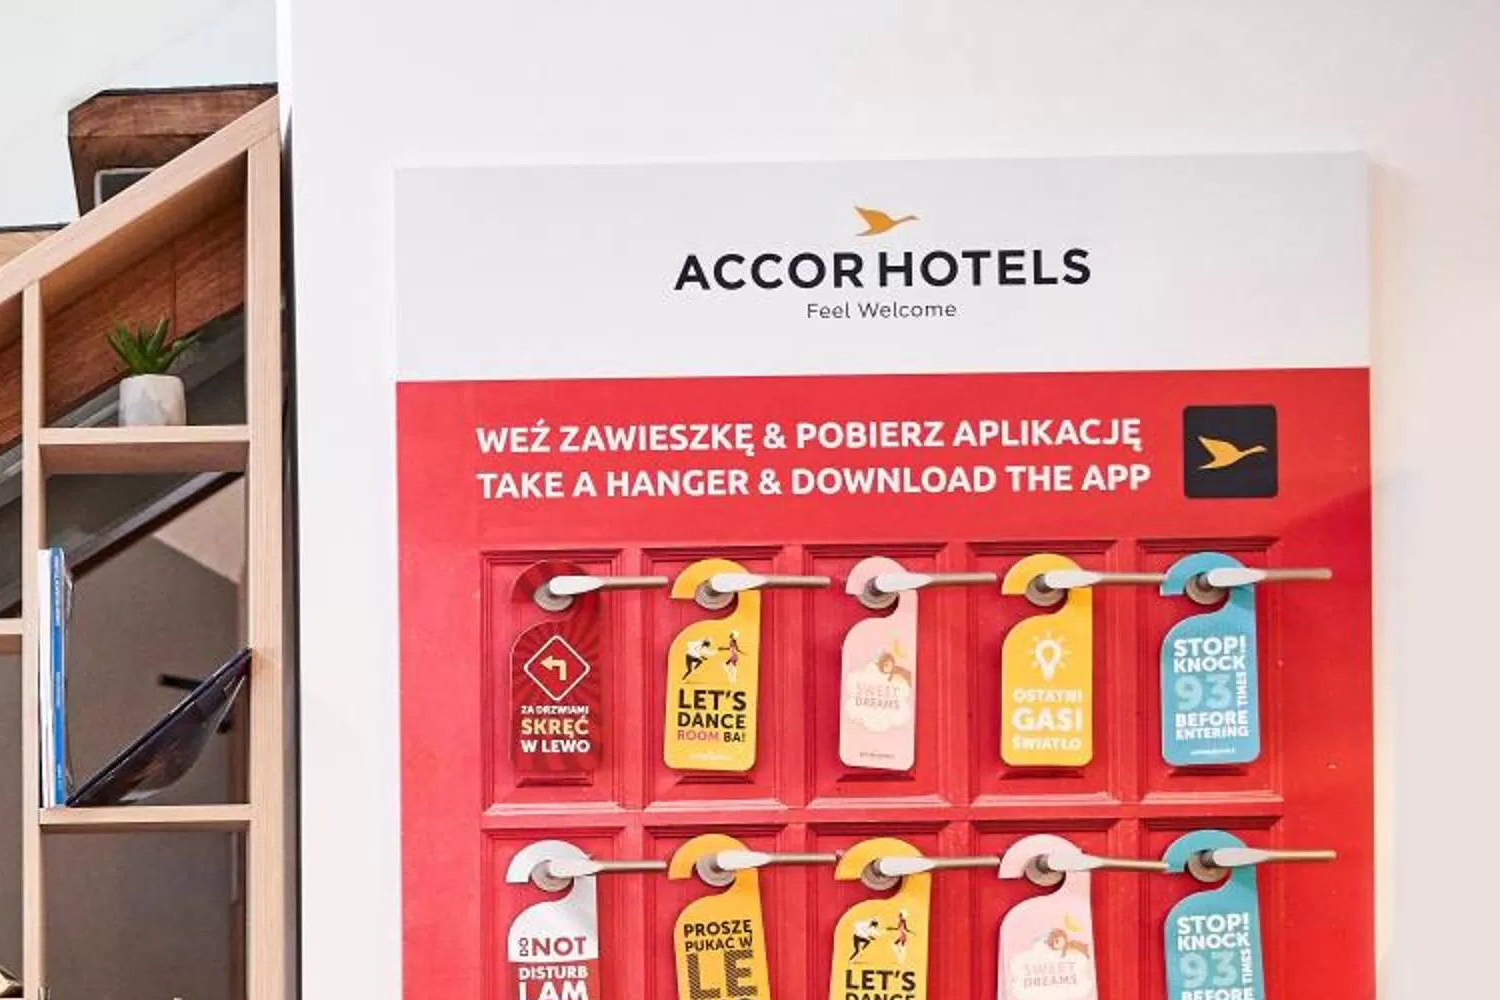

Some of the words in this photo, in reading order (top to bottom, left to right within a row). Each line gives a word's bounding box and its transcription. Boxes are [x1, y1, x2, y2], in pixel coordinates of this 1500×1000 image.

[807, 302, 851, 319] Feel
[857, 301, 957, 319] Welcome
[476, 418, 550, 453] WEŹ
[559, 423, 755, 457] ZAWIESZKĘ
[763, 422, 787, 449] &
[796, 421, 945, 449] POBIERZ
[952, 418, 1143, 452] APLIKACJĘ
[476, 471, 565, 499] TAKE
[572, 471, 597, 497] A
[607, 469, 749, 497] HANGER
[758, 468, 783, 495] &
[791, 465, 997, 495] DOWNLOAD
[1005, 465, 1073, 492] THE
[1081, 463, 1151, 491] APP
[1173, 635, 1247, 657] STOP!
[1173, 655, 1246, 673] KNOCK
[1174, 674, 1232, 712] 93
[1236, 671, 1248, 706] TIMES
[677, 689, 747, 711] LET'S
[521, 716, 589, 740] SKRĘĆ
[677, 713, 746, 730] DANCE
[1011, 707, 1083, 733] GASI
[1175, 709, 1249, 728] BEFORE
[677, 730, 720, 743] ROOM
[723, 731, 746, 744] BA!
[1175, 725, 1250, 741] ENTERING
[521, 740, 540, 754] W
[542, 739, 591, 754] LEWO
[1176, 911, 1250, 936] STOP!
[532, 936, 587, 957] NOT
[739, 936, 754, 950] W
[1177, 931, 1251, 951] KNOCK
[518, 965, 589, 981] DISTURB
[687, 949, 759, 1000] LE
[1179, 950, 1238, 989] 93
[1240, 947, 1253, 985] TIMES
[845, 968, 917, 992] LET'S
